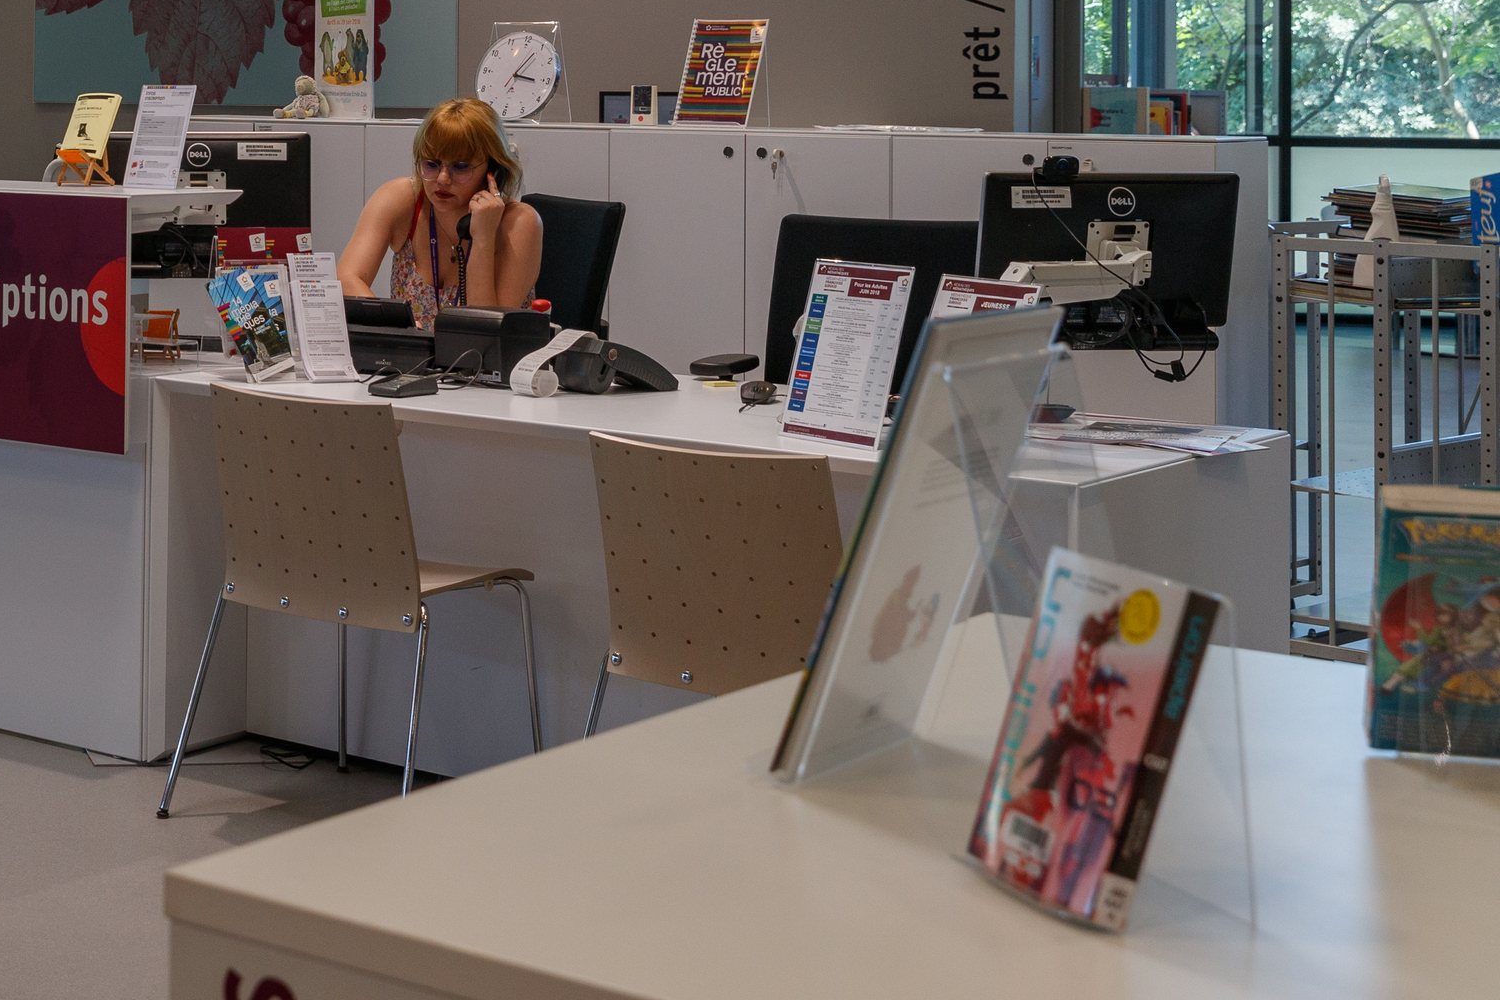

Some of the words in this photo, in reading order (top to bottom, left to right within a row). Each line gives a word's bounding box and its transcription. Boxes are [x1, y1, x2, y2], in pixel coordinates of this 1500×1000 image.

[492, 50, 499, 58] 10
[962, 27, 1009, 100] prêt
[483, 66, 488, 74] 9
[704, 86, 741, 96] PUBLIC
[502, 108, 508, 116] 6
[520, 106, 525, 114] 5
[1110, 197, 1132, 206] DELL
[232, 296, 243, 307] 14
[980, 301, 1011, 310] JEUNESSE
[243, 314, 266, 330] ques
